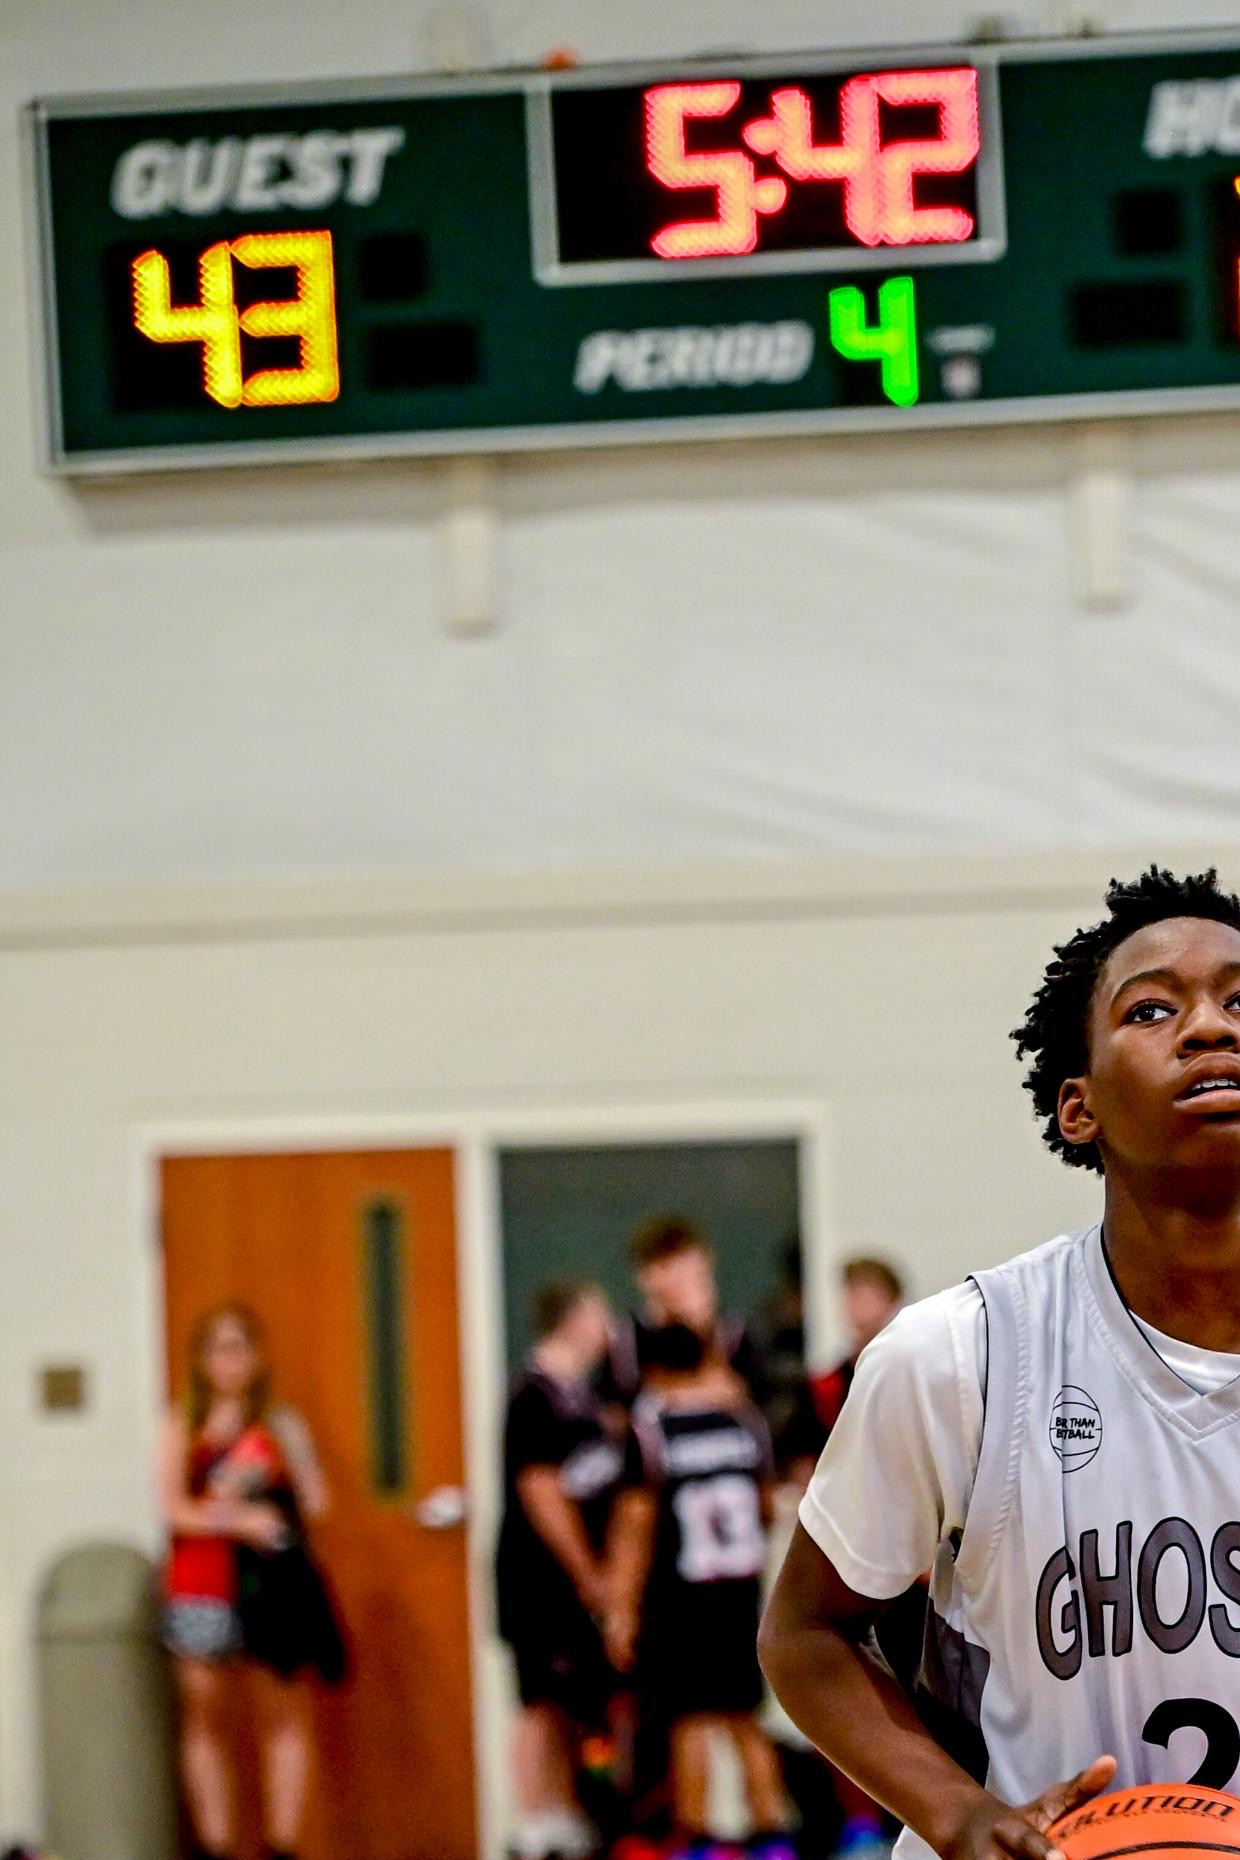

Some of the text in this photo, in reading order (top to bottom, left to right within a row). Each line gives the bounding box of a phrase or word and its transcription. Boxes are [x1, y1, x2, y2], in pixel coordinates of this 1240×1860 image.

[112, 127, 404, 219] GUEST
[644, 67, 979, 258] 5:42
[133, 230, 340, 408] 43
[573, 276, 918, 407] PERIOD 4
